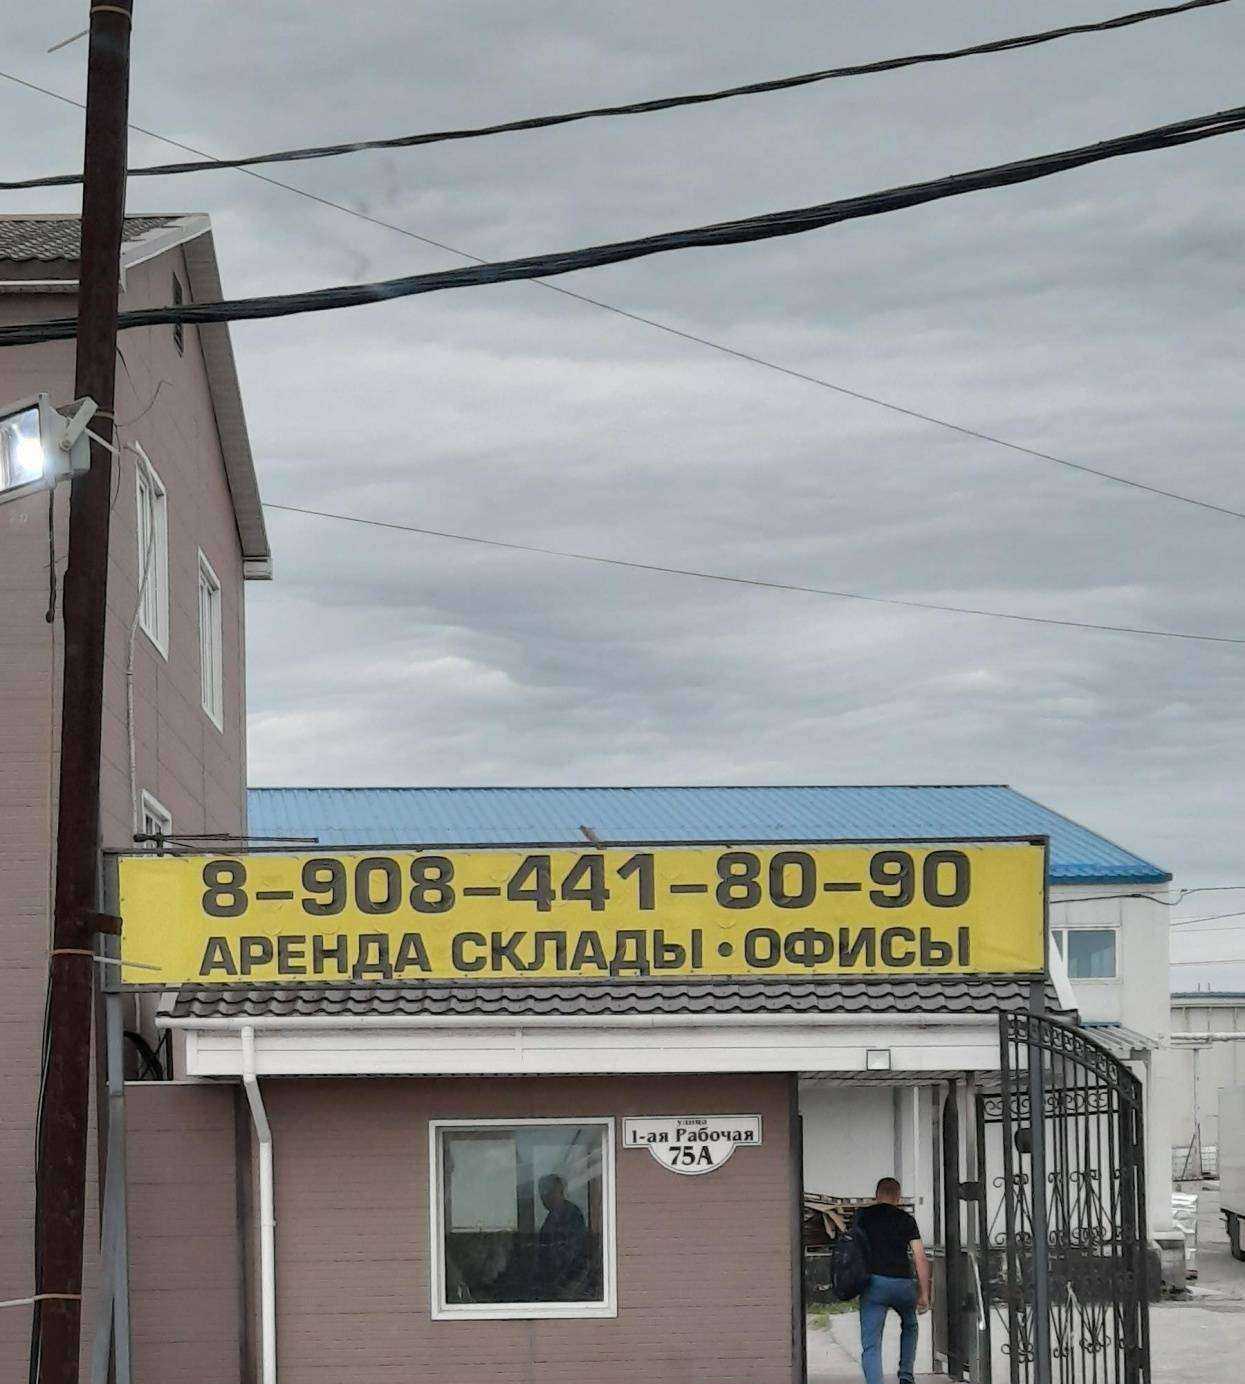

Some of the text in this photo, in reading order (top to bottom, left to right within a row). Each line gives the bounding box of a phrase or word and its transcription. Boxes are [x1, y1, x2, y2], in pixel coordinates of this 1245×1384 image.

[201, 849, 971, 917] 8-908-441-80-90
[199, 925, 971, 979] АРЕНДА СКЛАДЫ ОФИСЫ
[676, 1127, 754, 1142] Рабочая
[668, 1145, 714, 1166] 75А
